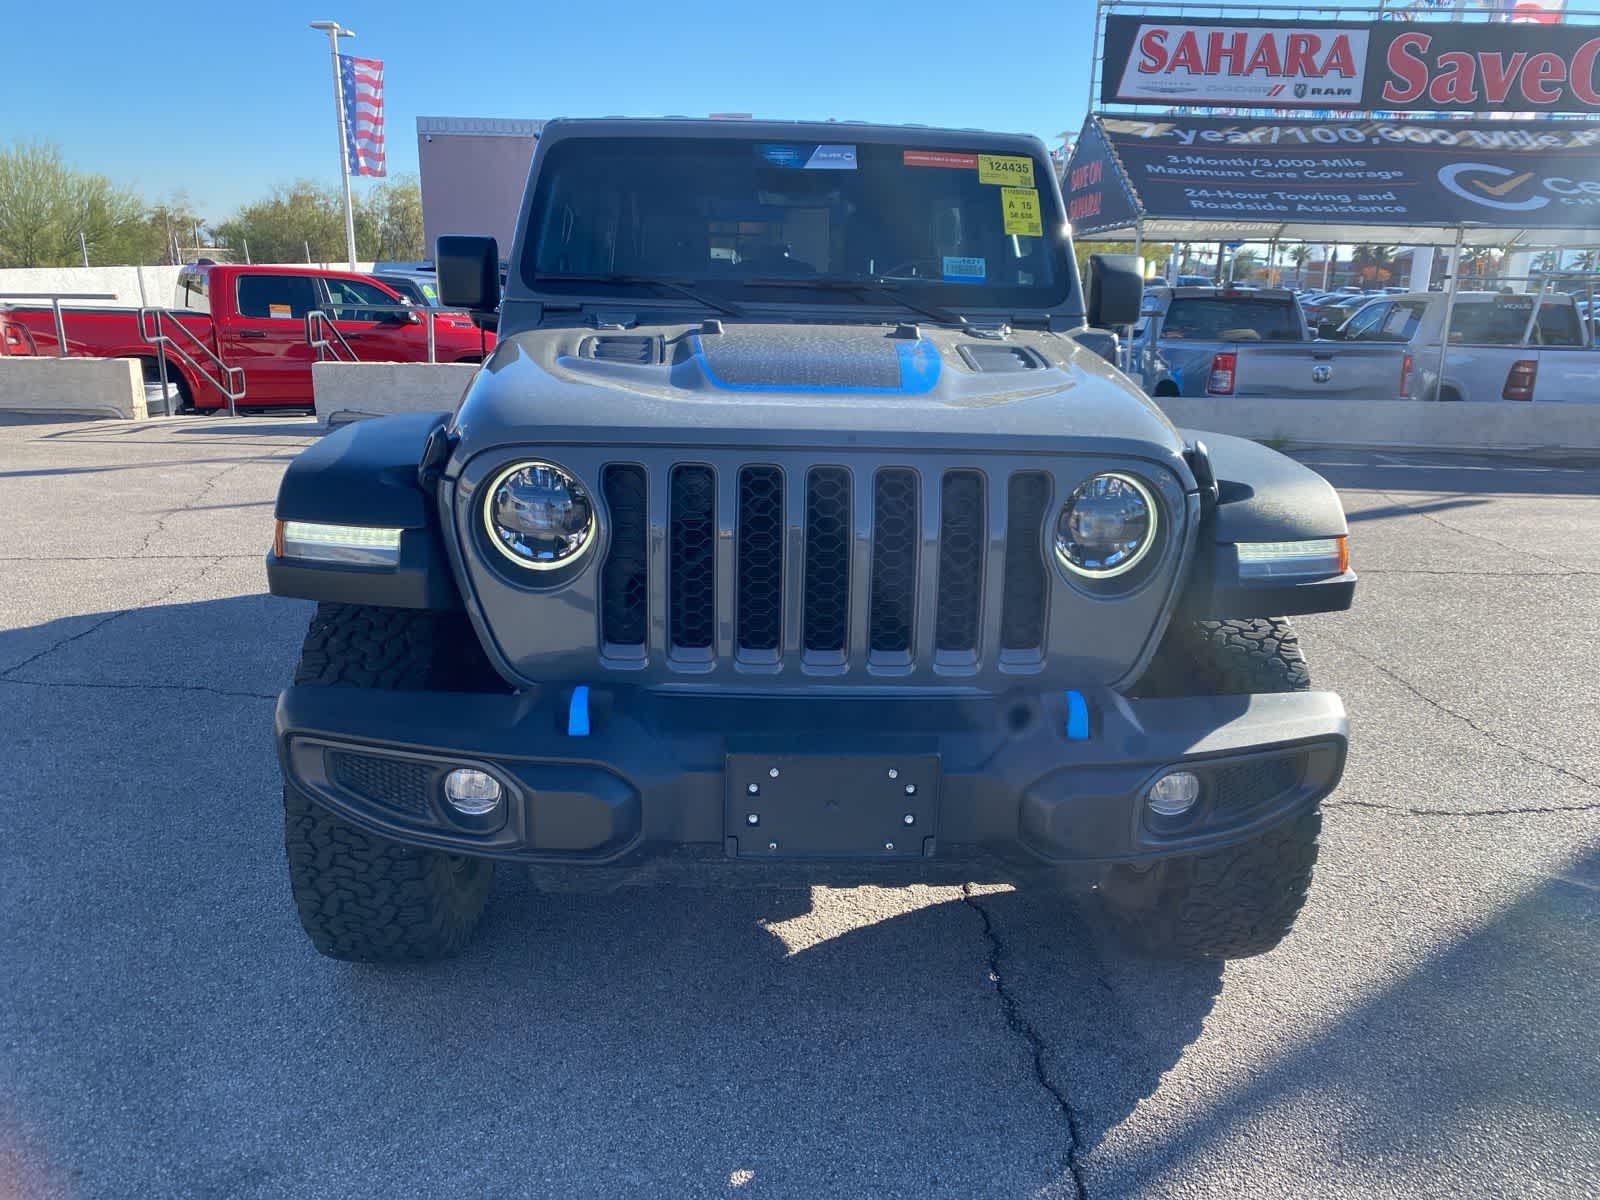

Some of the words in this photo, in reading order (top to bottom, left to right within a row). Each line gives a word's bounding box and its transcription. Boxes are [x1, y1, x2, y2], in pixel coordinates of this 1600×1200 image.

[1137, 28, 1357, 79] SAHARA
[1311, 87, 1353, 96] RAM
[989, 161, 1029, 174] 124435
[1167, 155, 1368, 169] 3-Month/3,000-Mile
[1145, 164, 1248, 178] Maximum
[1251, 168, 1297, 179] Care
[1303, 170, 1404, 181] Coverage
[1184, 188, 1269, 201] 24-Hour
[1274, 191, 1351, 203] Towing
[1357, 191, 1397, 202] and
[1008, 200, 1016, 209] A
[1190, 199, 1289, 213] Roadside
[1296, 203, 1408, 214] Assistance
